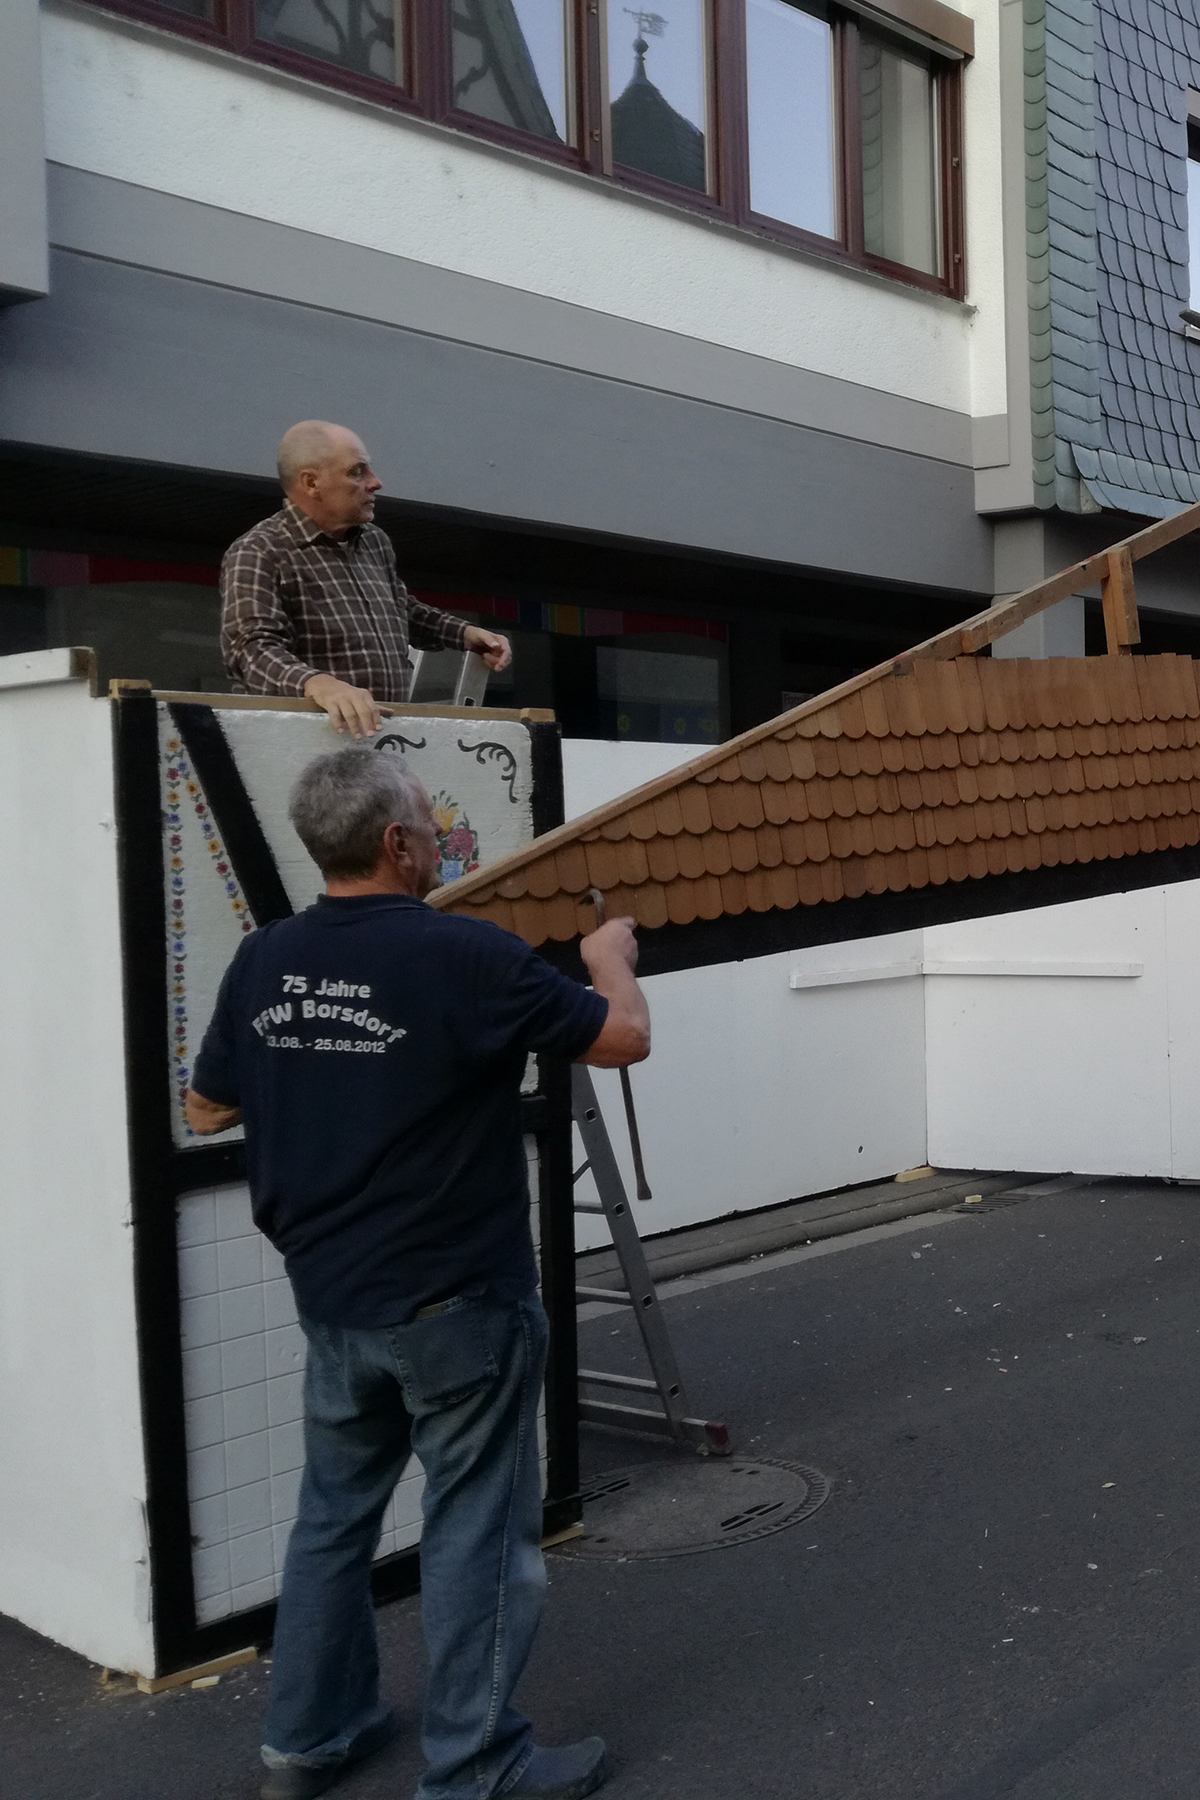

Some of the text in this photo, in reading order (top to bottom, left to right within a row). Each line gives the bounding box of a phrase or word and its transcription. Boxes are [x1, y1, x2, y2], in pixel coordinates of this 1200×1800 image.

[282, 975, 372, 998] 75 Jahre
[252, 999, 407, 1043] FFW Borsdorf
[314, 1038, 386, 1053] 25.08.2012
